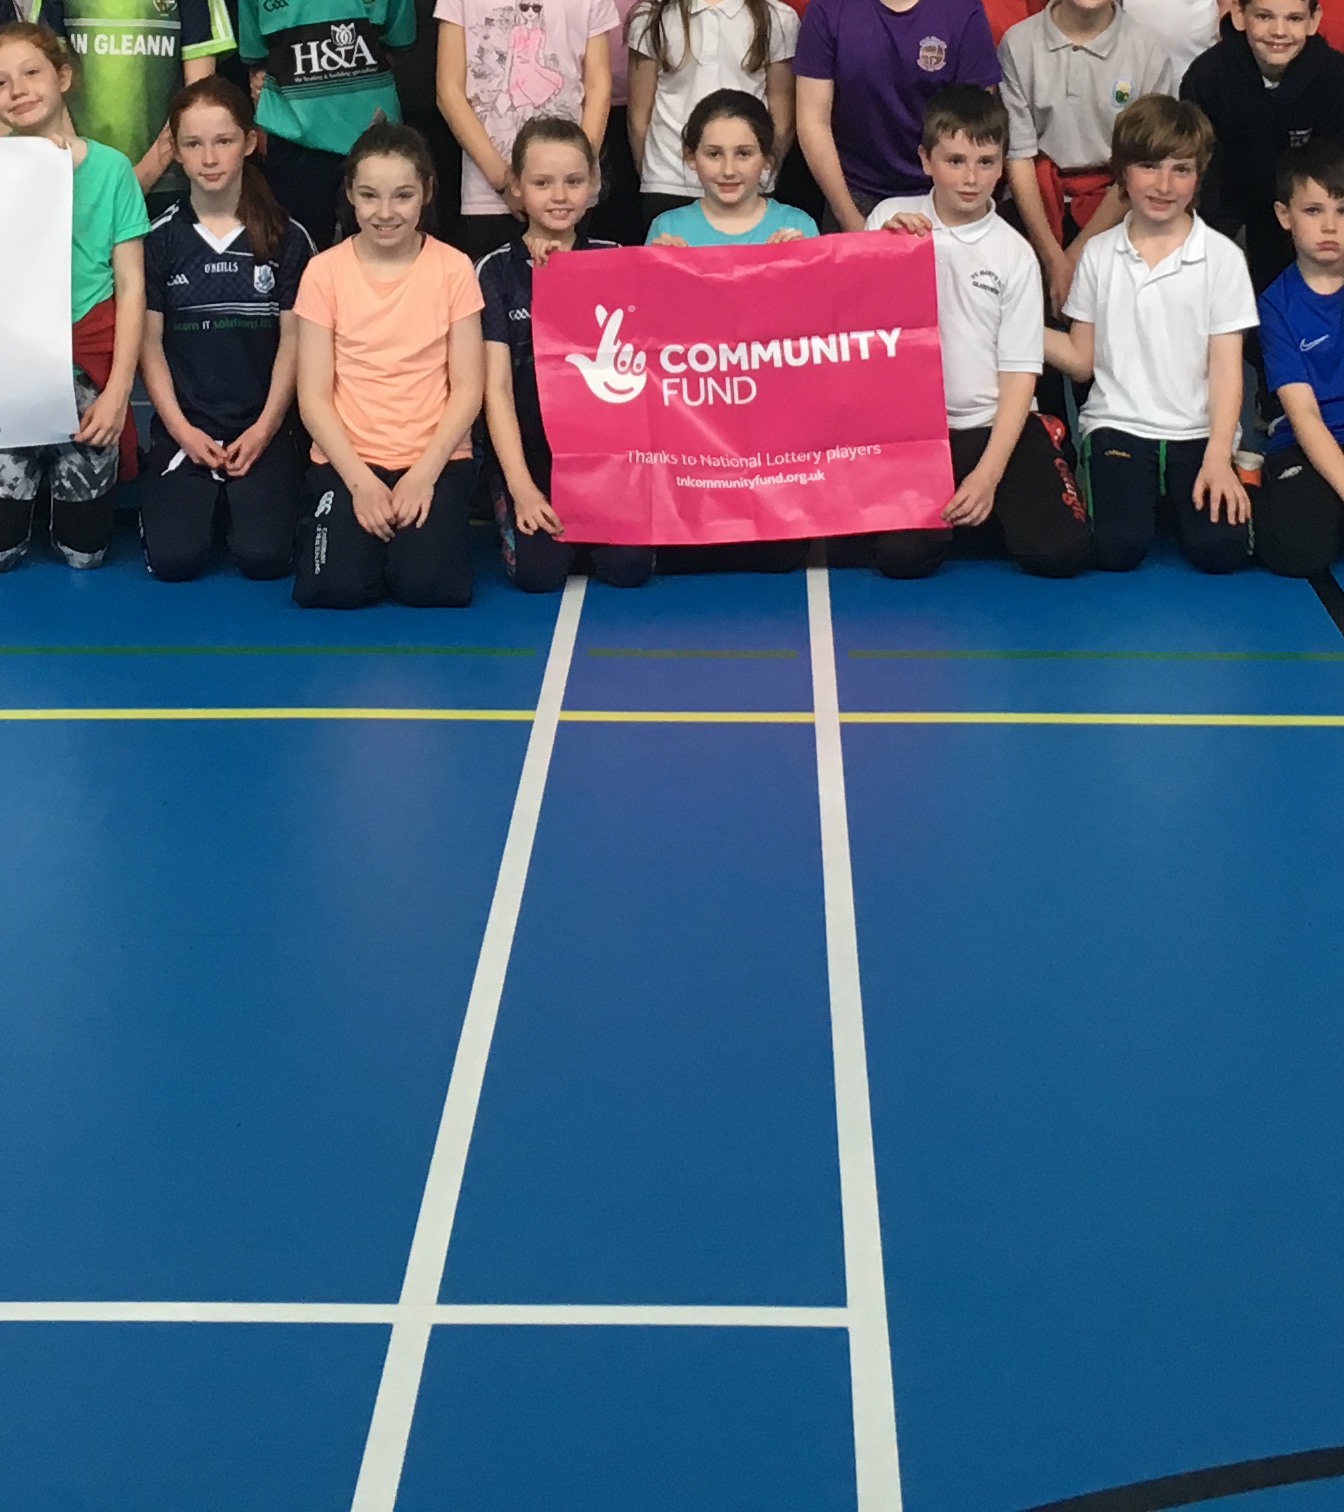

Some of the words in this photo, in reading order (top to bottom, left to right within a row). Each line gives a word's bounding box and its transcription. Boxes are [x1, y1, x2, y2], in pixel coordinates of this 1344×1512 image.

[94, 34, 175, 56] GLEANN
[291, 35, 378, 75] H&A
[204, 261, 238, 273] O'NEILLS
[202, 320, 210, 329] IT
[659, 327, 902, 373] COMMUNITY
[662, 376, 757, 406] FUND
[627, 450, 678, 465] Thanks
[682, 453, 697, 467] to
[700, 452, 761, 469] National
[766, 451, 821, 467] Lottery
[825, 444, 881, 462] players
[676, 469, 825, 490] tnlcommunityfund.org.uk
